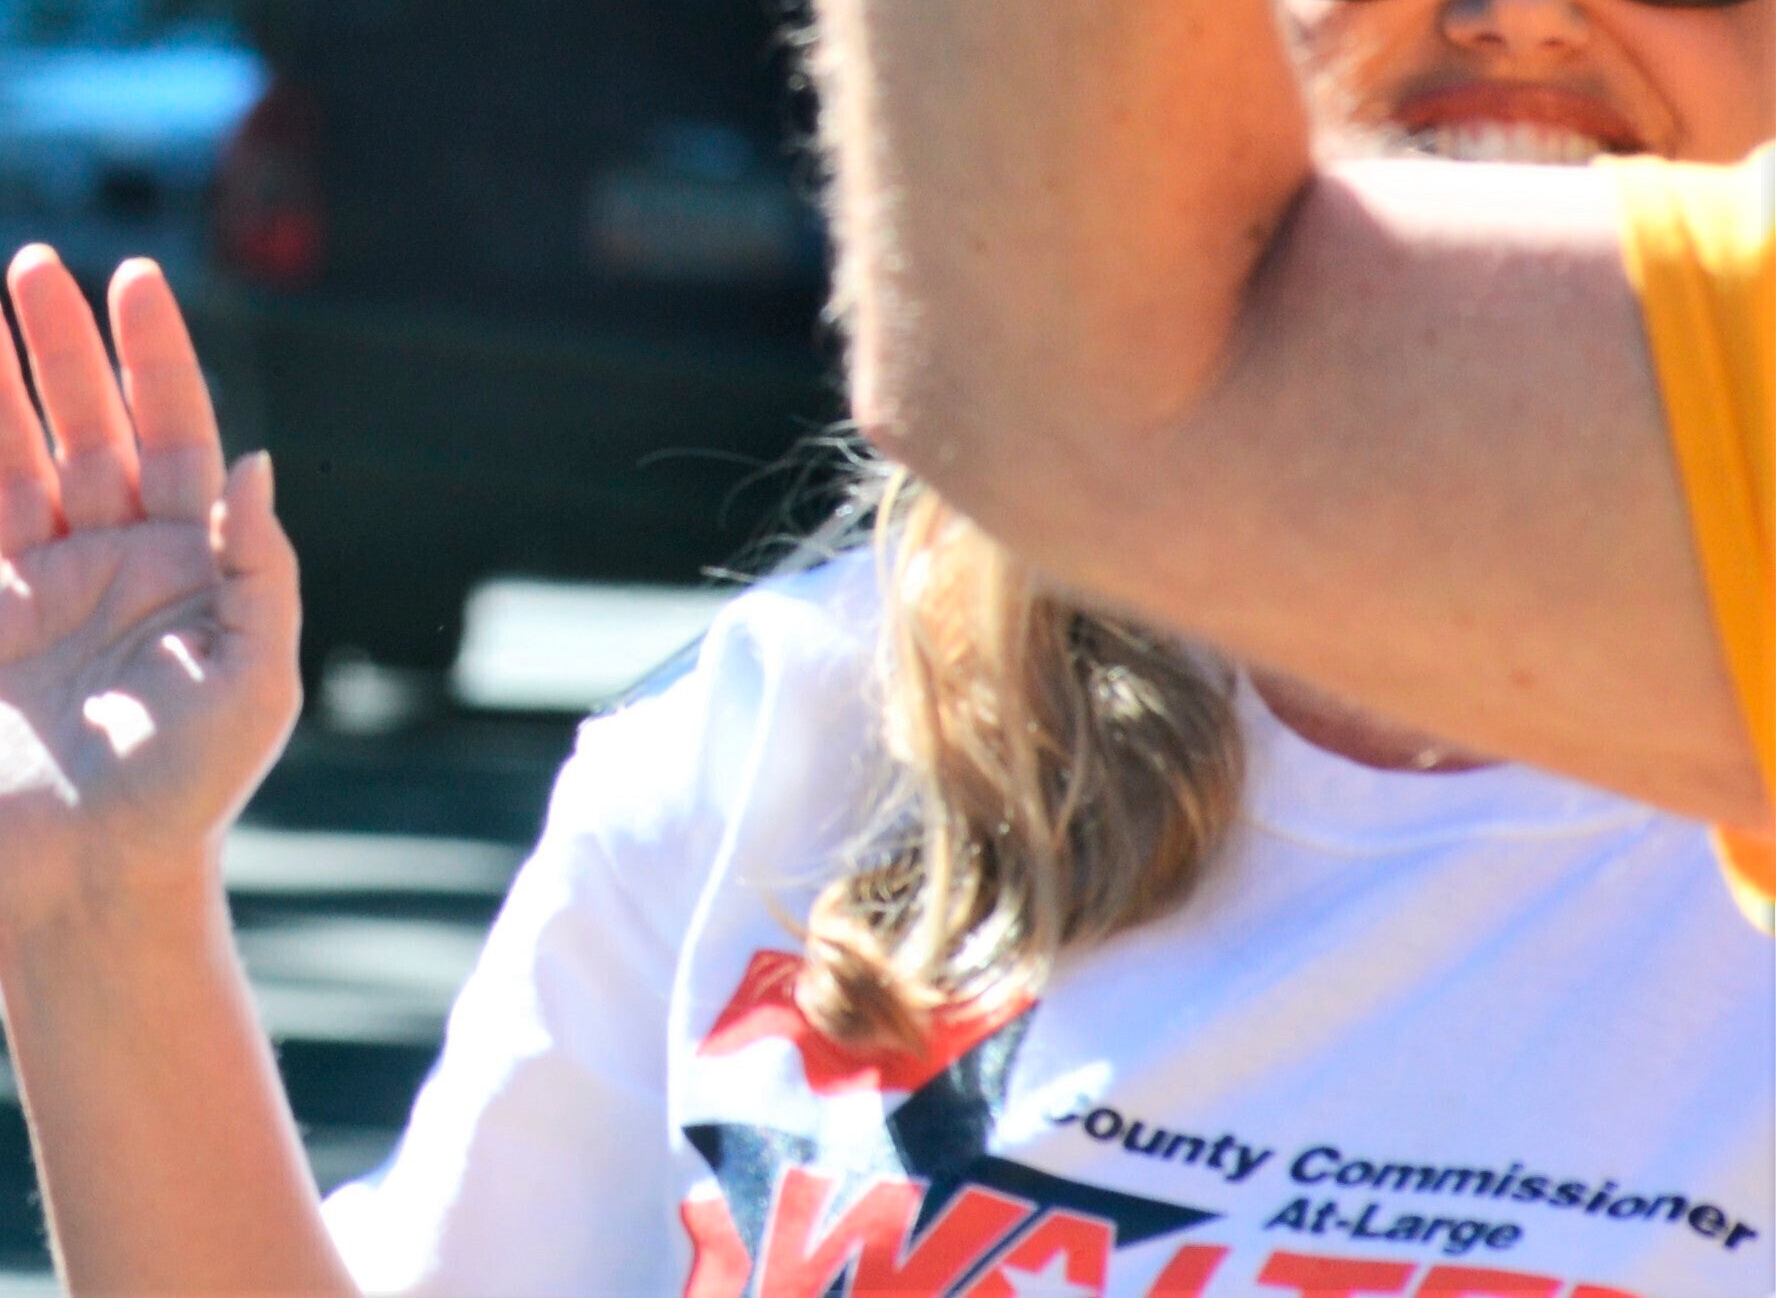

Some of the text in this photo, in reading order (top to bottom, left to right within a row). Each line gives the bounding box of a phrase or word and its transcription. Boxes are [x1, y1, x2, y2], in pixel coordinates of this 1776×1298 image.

[1048, 1098, 1761, 1253] ounty Commissioner
[1262, 1195, 1525, 1259] At-Large
